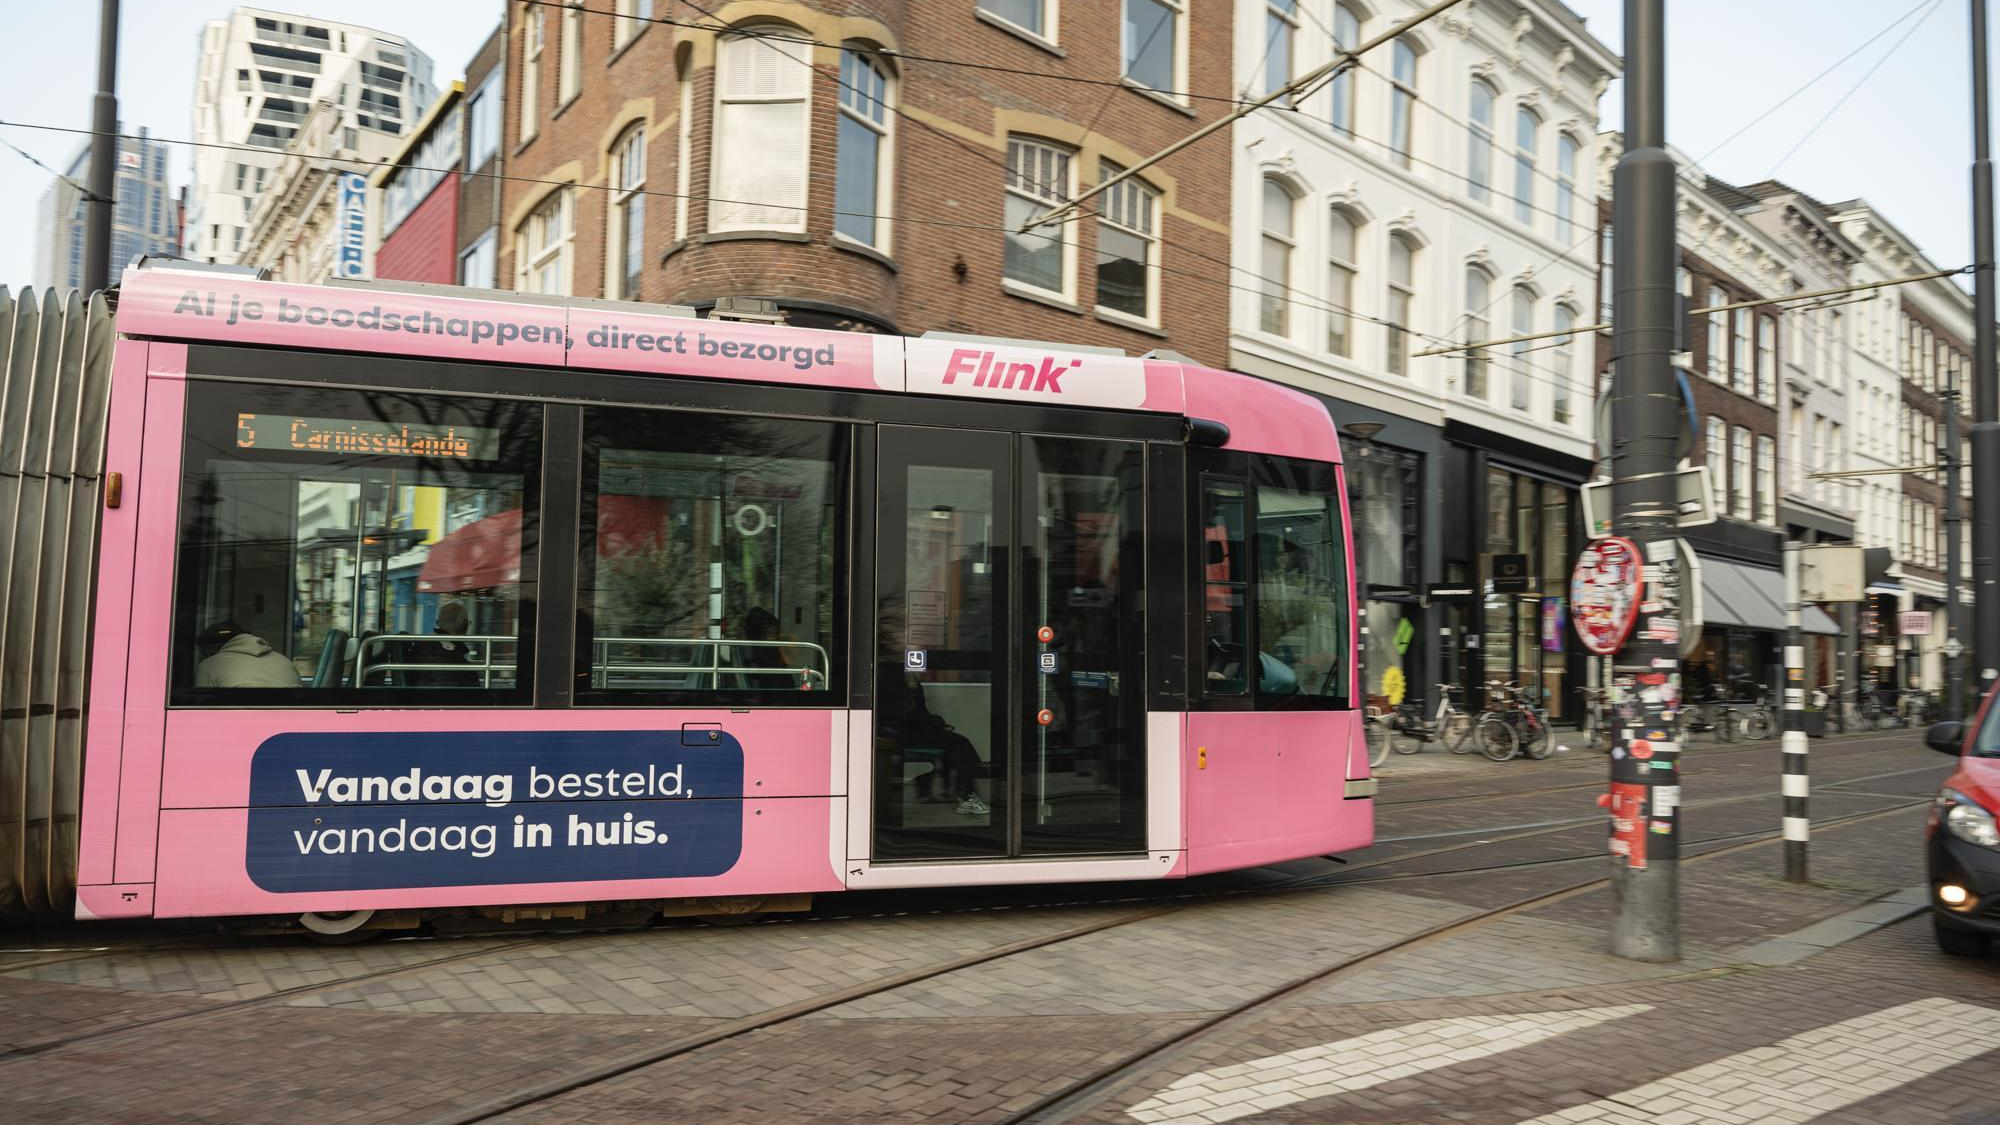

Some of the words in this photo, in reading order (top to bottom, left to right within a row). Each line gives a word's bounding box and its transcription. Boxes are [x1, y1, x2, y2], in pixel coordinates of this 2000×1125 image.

[174, 290, 217, 318] Al
[226, 293, 264, 325] je
[278, 298, 574, 350] boodschappen,
[586, 324, 687, 354] direct
[698, 332, 835, 369] bezorgd
[942, 349, 1082, 394] Flink
[237, 412, 255, 448] 5
[291, 418, 468, 457] Carnisselande
[296, 768, 513, 807] Vandaag
[529, 764, 693, 799] besteld,
[294, 819, 497, 858] vandaag
[513, 815, 553, 848] in
[567, 812, 669, 846] huis.
